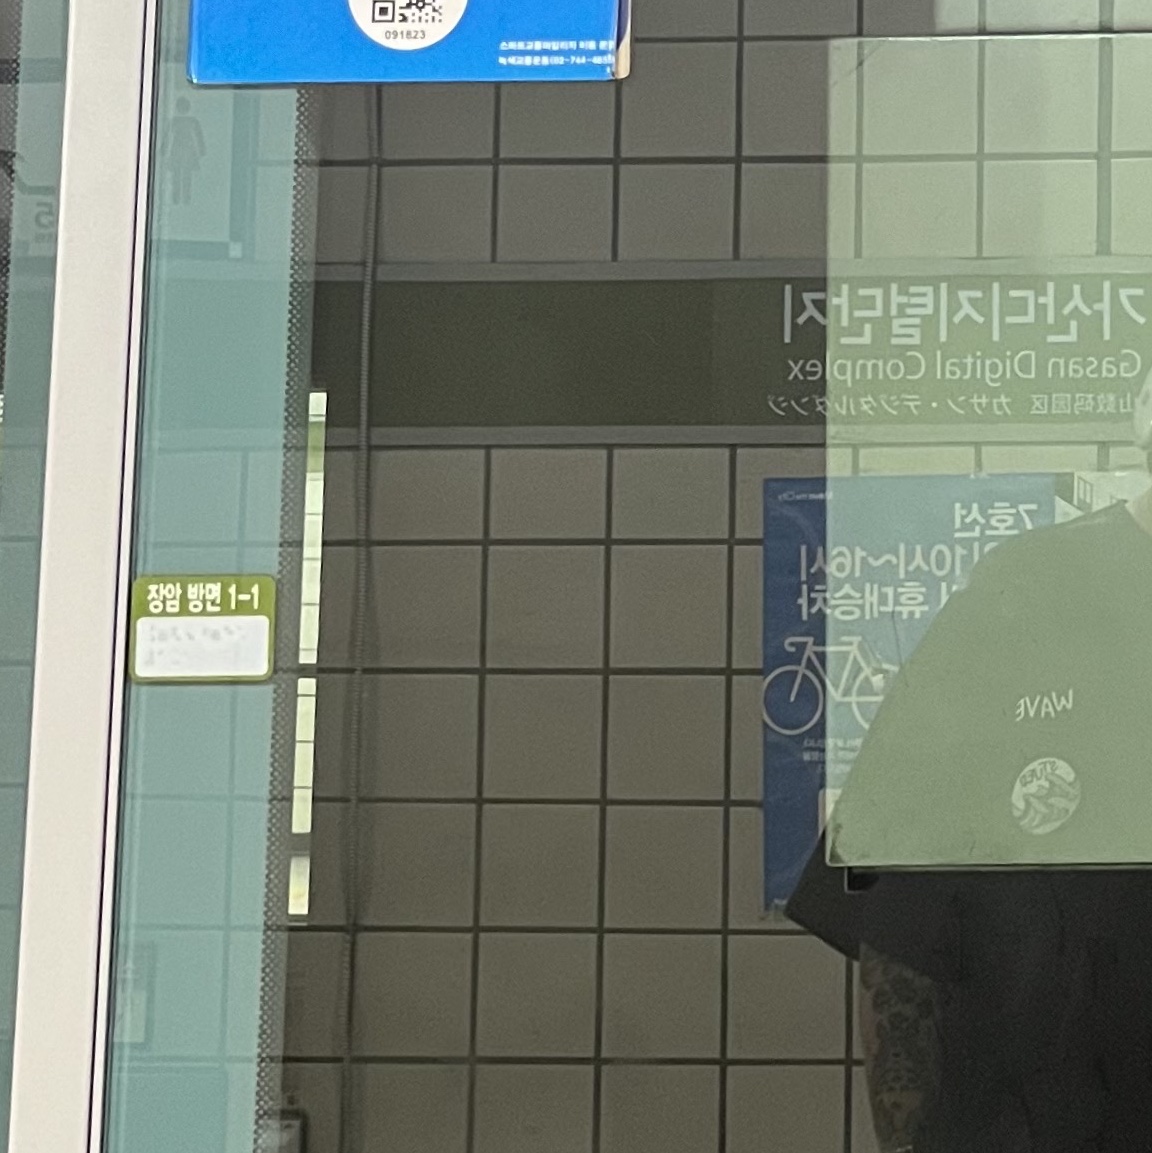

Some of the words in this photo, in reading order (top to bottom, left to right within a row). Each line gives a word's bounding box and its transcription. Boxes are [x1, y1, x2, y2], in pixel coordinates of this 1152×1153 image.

[384, 29, 426, 40] 091823
[146, 582, 183, 614] 장암
[187, 582, 222, 613] 방면
[228, 583, 260, 610] 1-1
